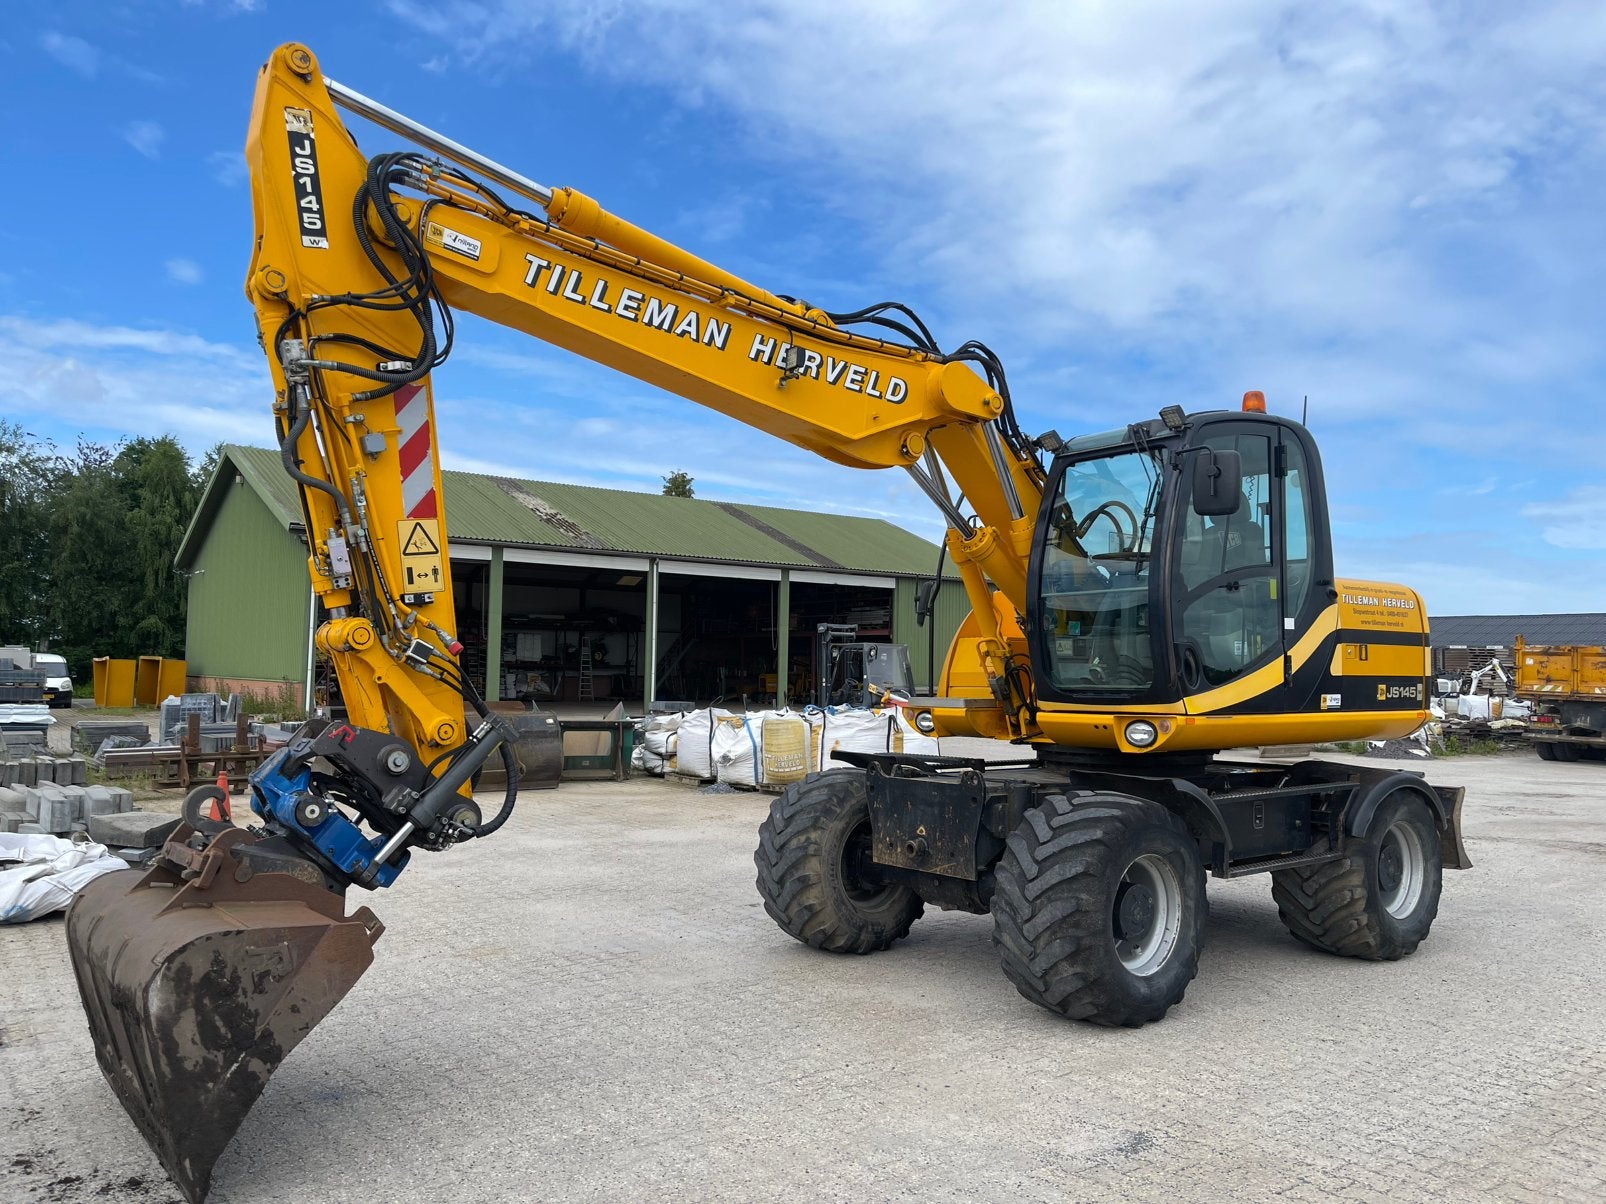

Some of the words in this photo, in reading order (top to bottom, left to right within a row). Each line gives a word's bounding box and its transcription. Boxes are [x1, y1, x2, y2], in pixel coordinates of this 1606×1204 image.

[294, 140, 322, 230] JS145
[308, 238, 320, 246] W
[524, 252, 731, 350] TILLEMAN
[747, 333, 909, 404] HERVELD
[1342, 594, 1379, 606] TILLEMAN
[1382, 597, 1415, 609] HERVELD
[1387, 687, 1416, 698] JS145
